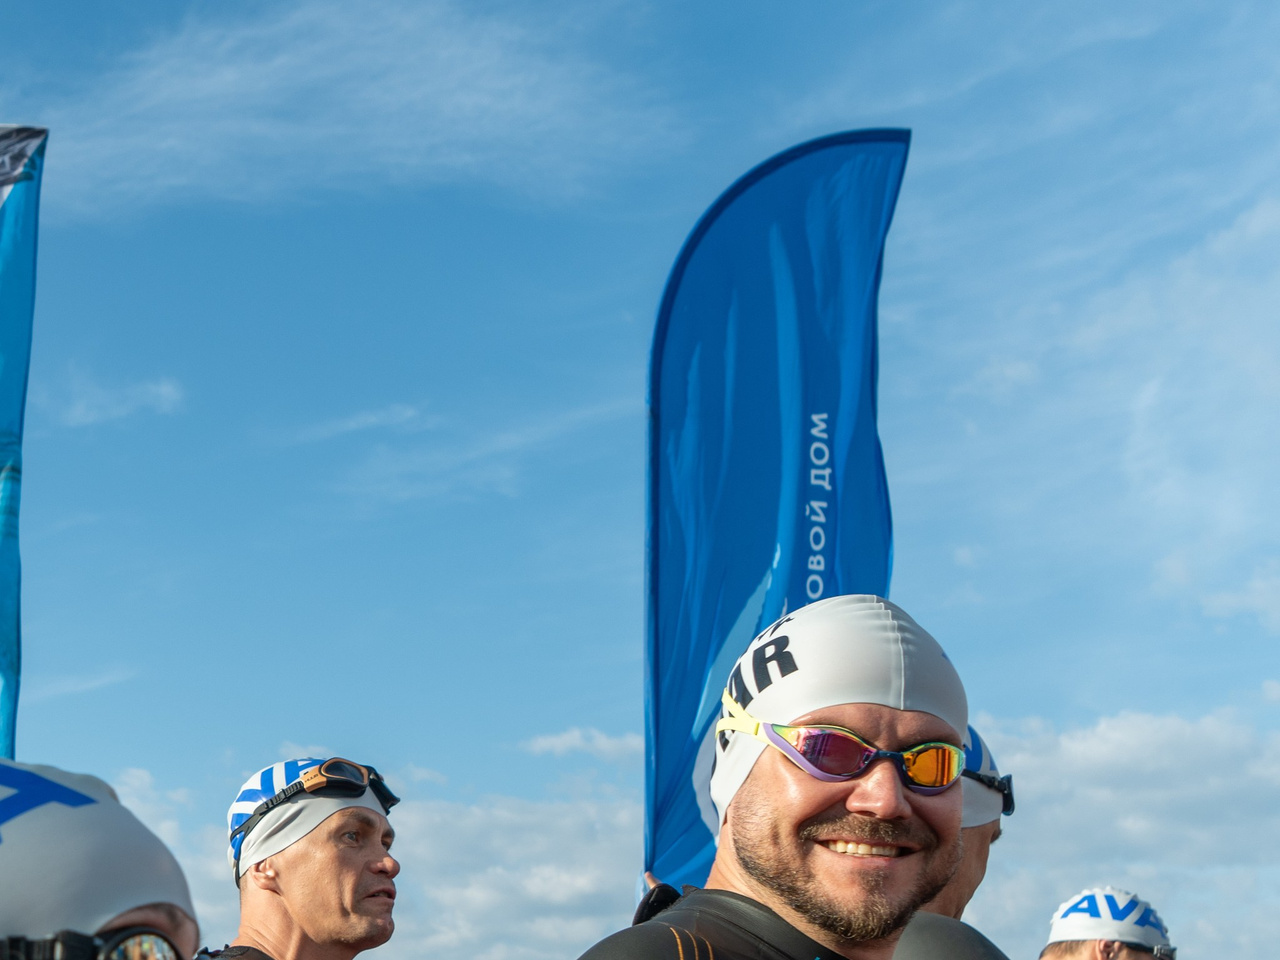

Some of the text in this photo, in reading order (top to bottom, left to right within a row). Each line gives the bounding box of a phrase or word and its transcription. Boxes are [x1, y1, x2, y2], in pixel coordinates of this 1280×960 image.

[806, 413, 832, 602] ОВОЙ ДОМ
[1061, 894, 1168, 940] AVA
